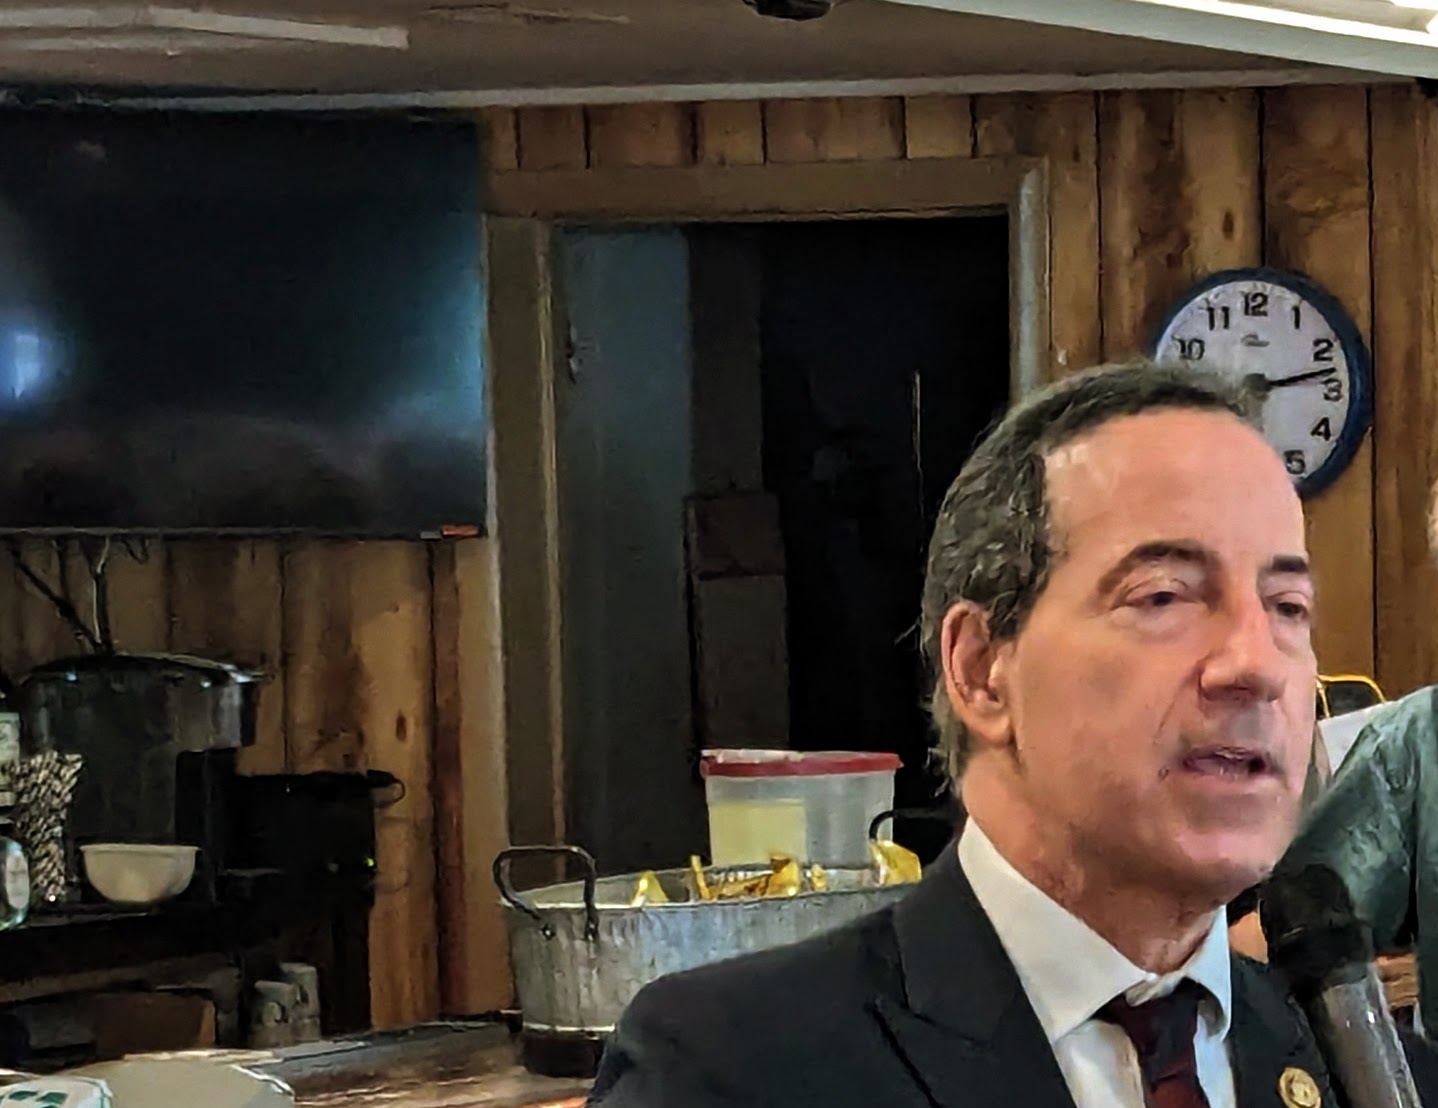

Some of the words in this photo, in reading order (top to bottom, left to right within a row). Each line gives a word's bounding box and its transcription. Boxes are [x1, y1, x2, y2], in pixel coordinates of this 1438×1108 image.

[1242, 292, 1269, 317] 12
[1207, 306, 1230, 331] 11
[1292, 305, 1301, 330] 1
[1176, 337, 1206, 361] 10
[1313, 338, 1334, 363] 2
[1322, 378, 1344, 402] 3
[1310, 416, 1332, 441] 4
[1284, 450, 1306, 475] 5
